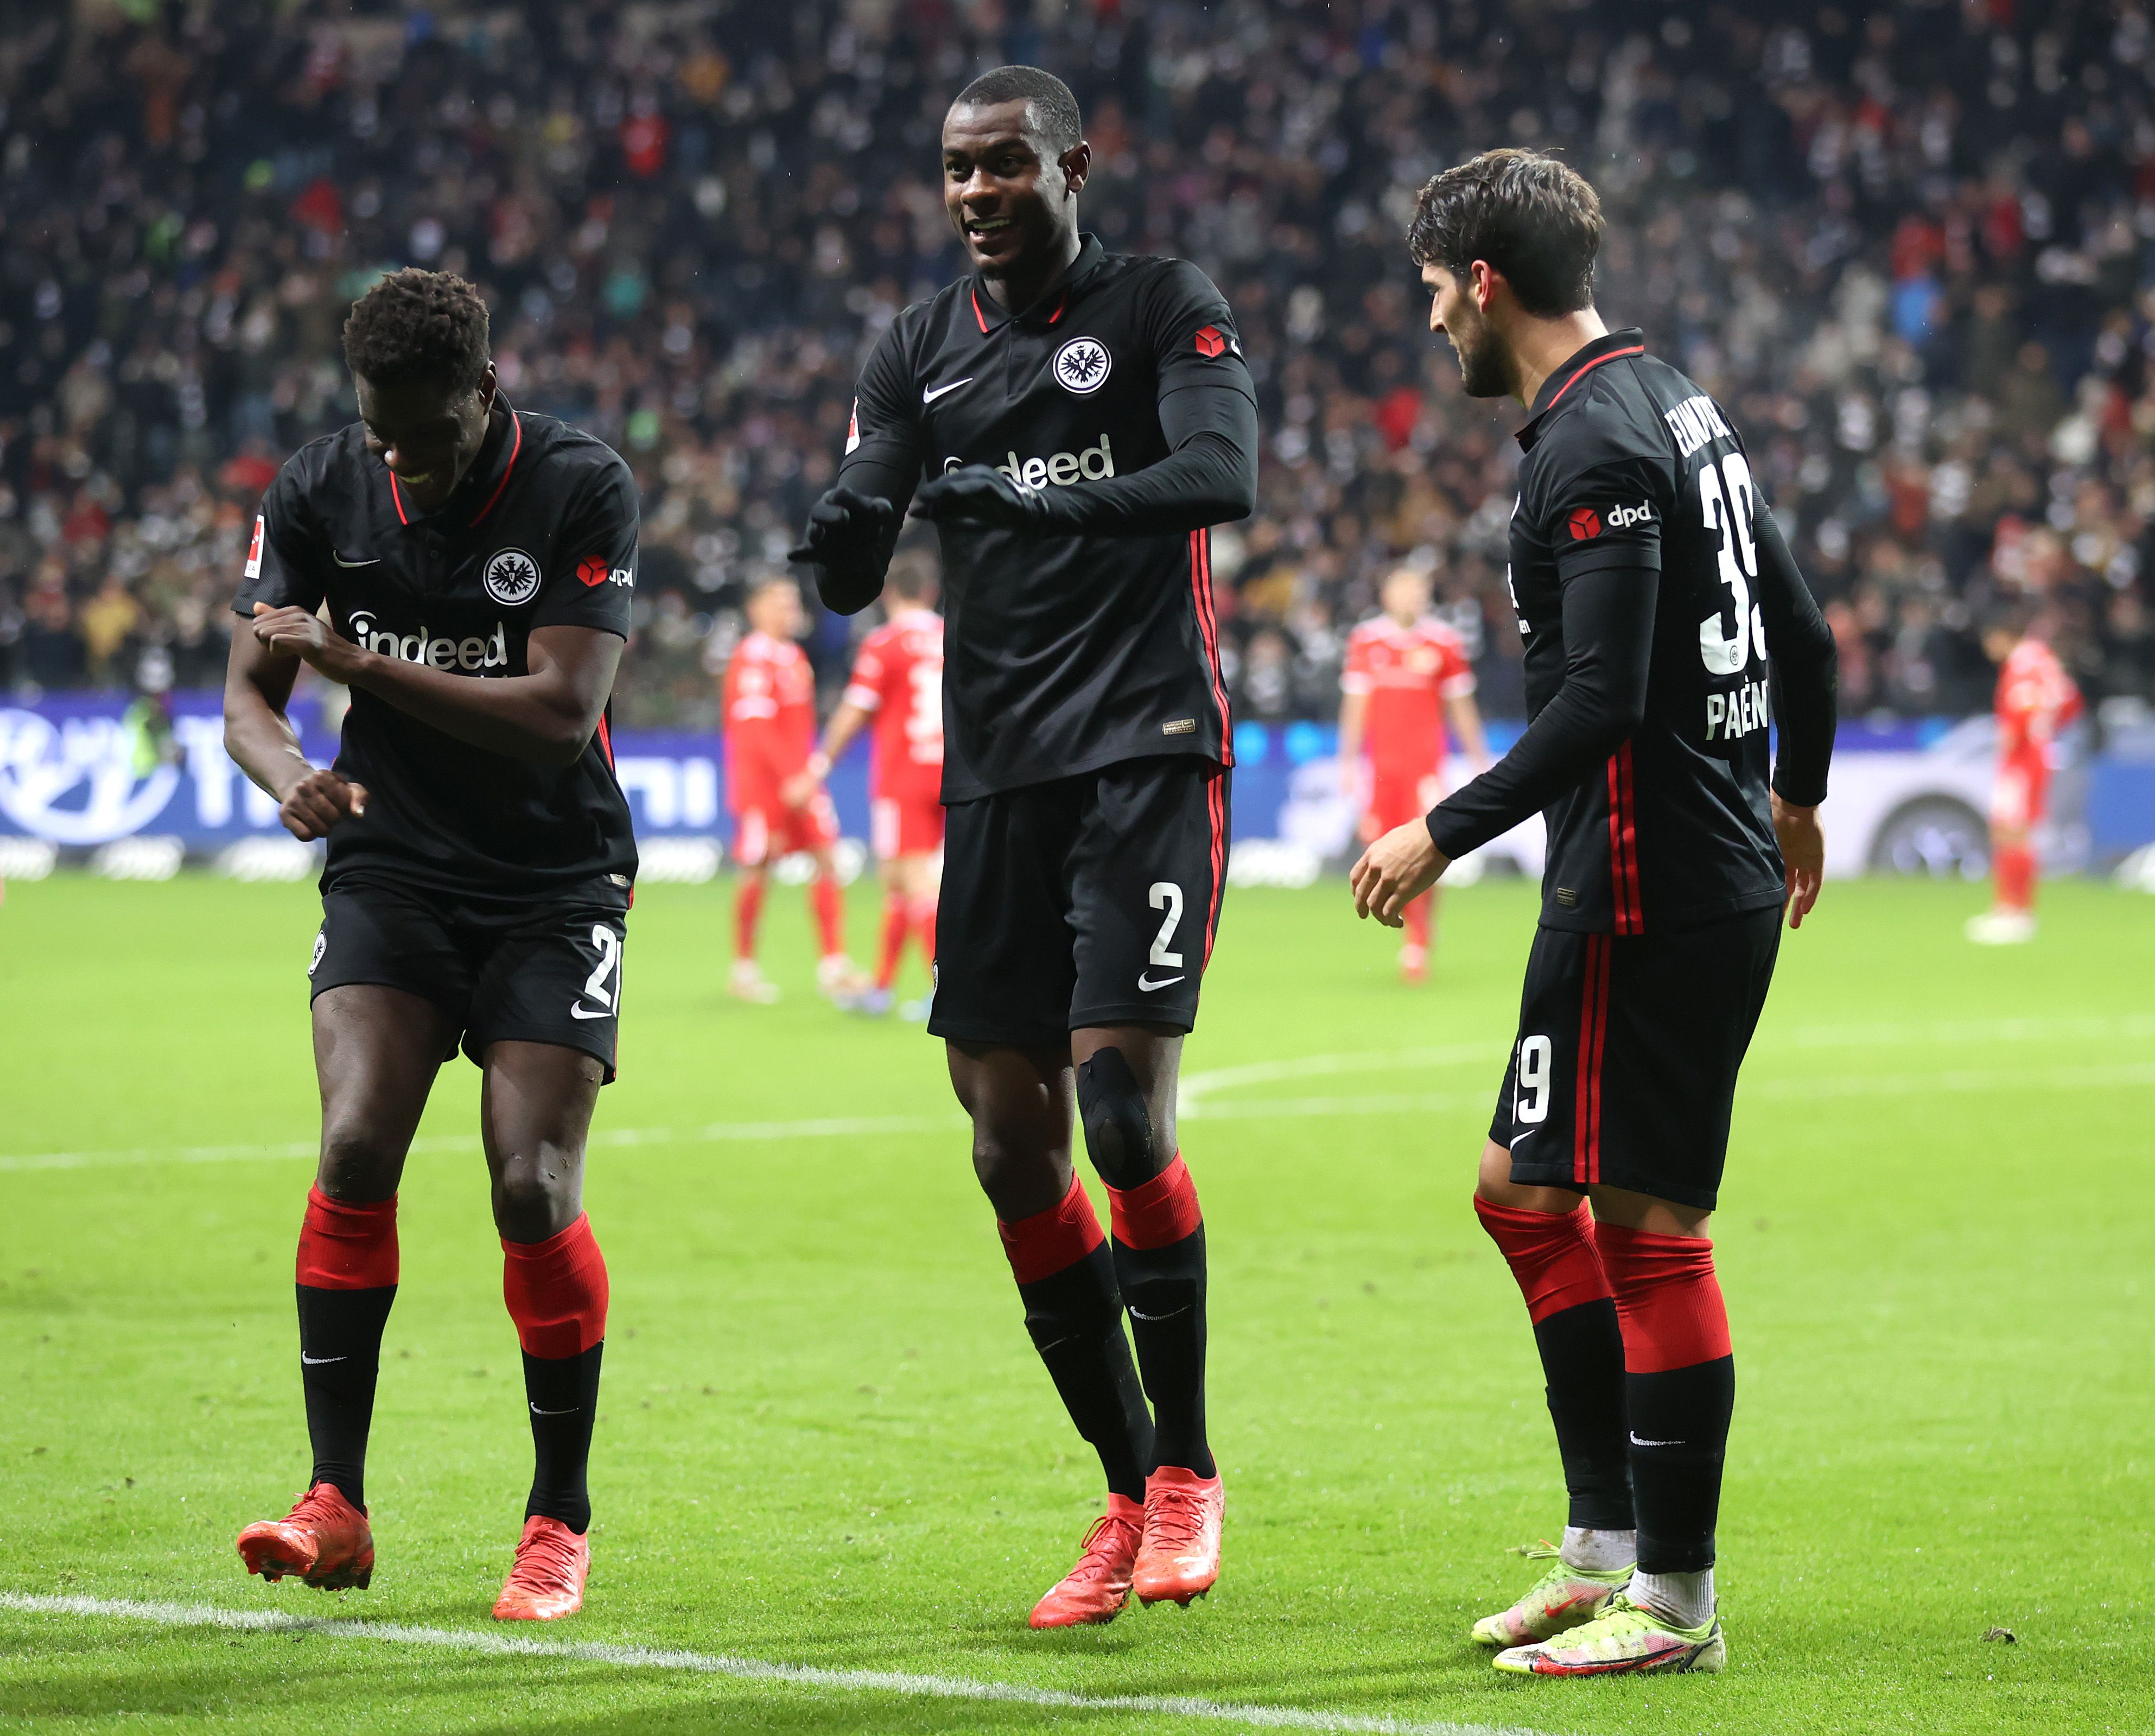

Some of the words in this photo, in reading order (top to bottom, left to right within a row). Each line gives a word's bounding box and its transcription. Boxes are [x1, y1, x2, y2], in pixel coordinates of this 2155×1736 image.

[1607, 499, 1652, 527] dpd
[349, 611, 508, 670] indeed
[1149, 882, 1183, 968] 2
